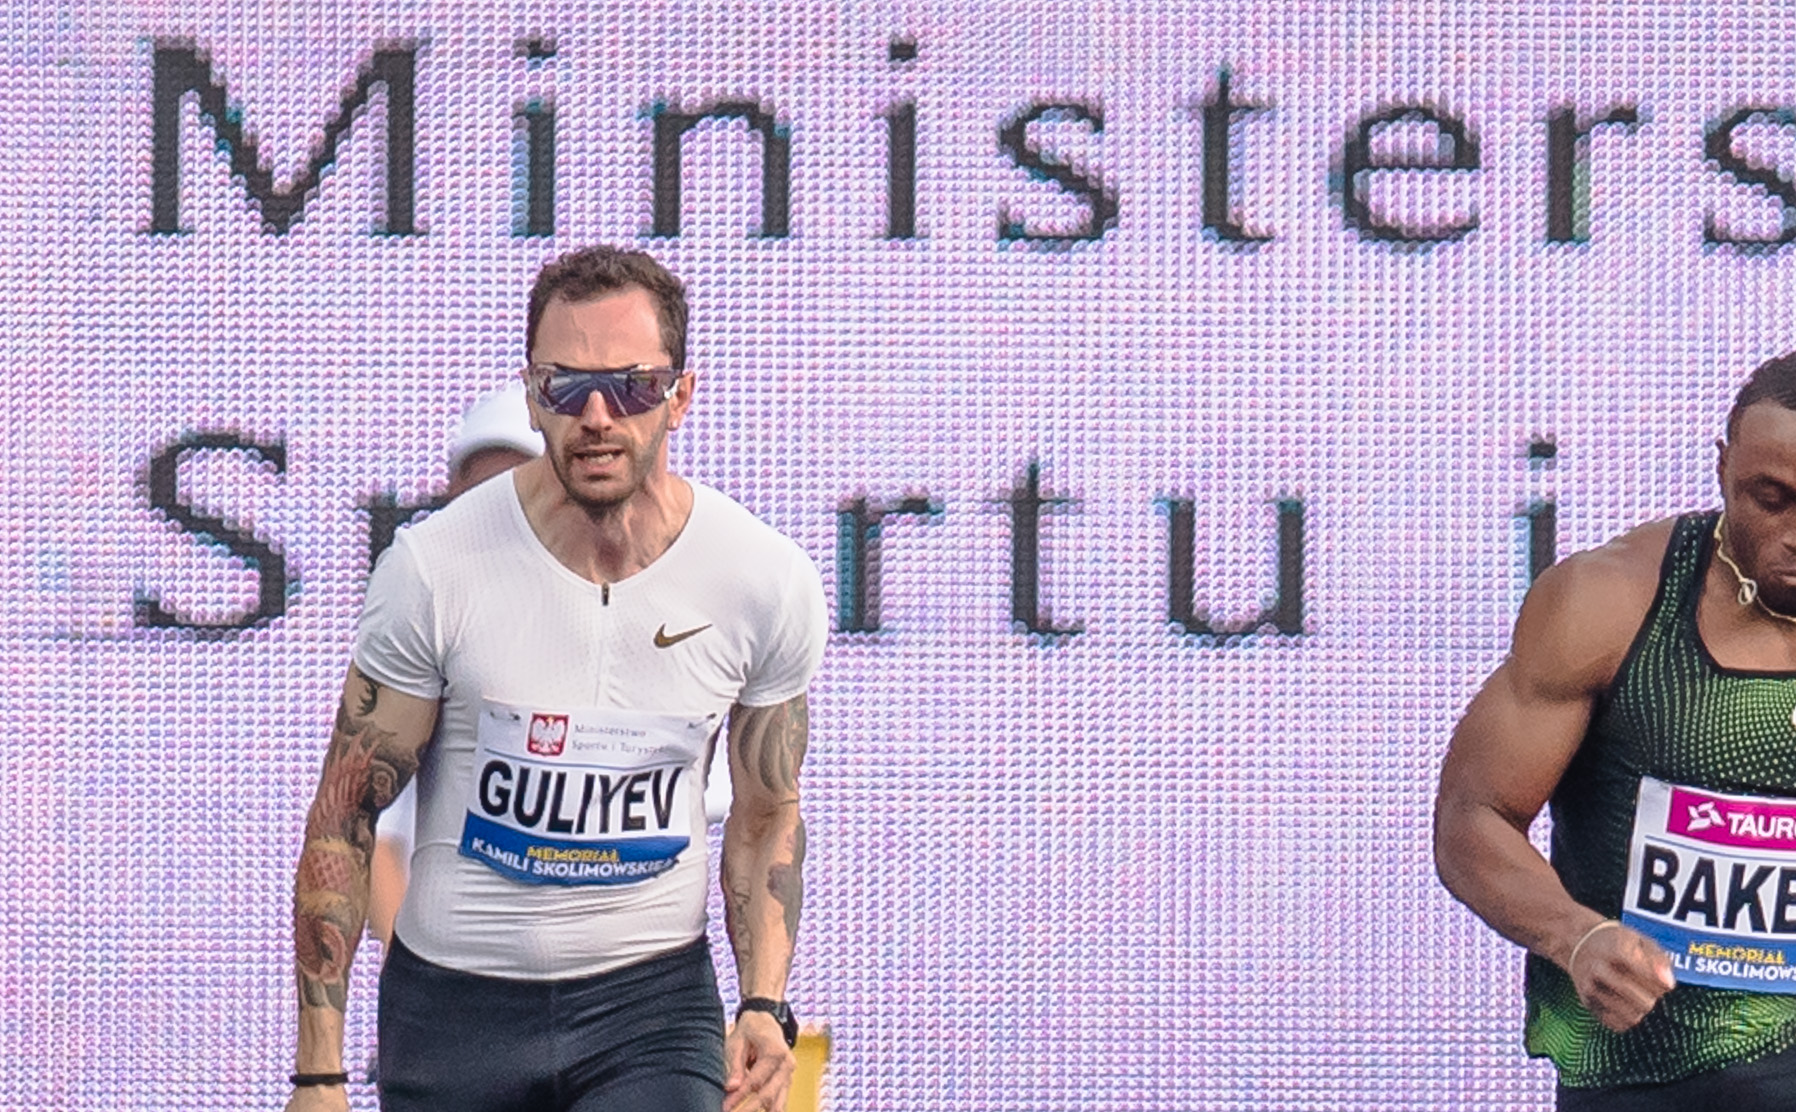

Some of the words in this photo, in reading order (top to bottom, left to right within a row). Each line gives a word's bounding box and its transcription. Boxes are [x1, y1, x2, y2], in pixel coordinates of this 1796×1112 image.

[133, 428, 1308, 643] Srtu
[1520, 438, 1557, 588] i
[479, 759, 684, 835] GULIYEV
[471, 837, 529, 872] KAMILI
